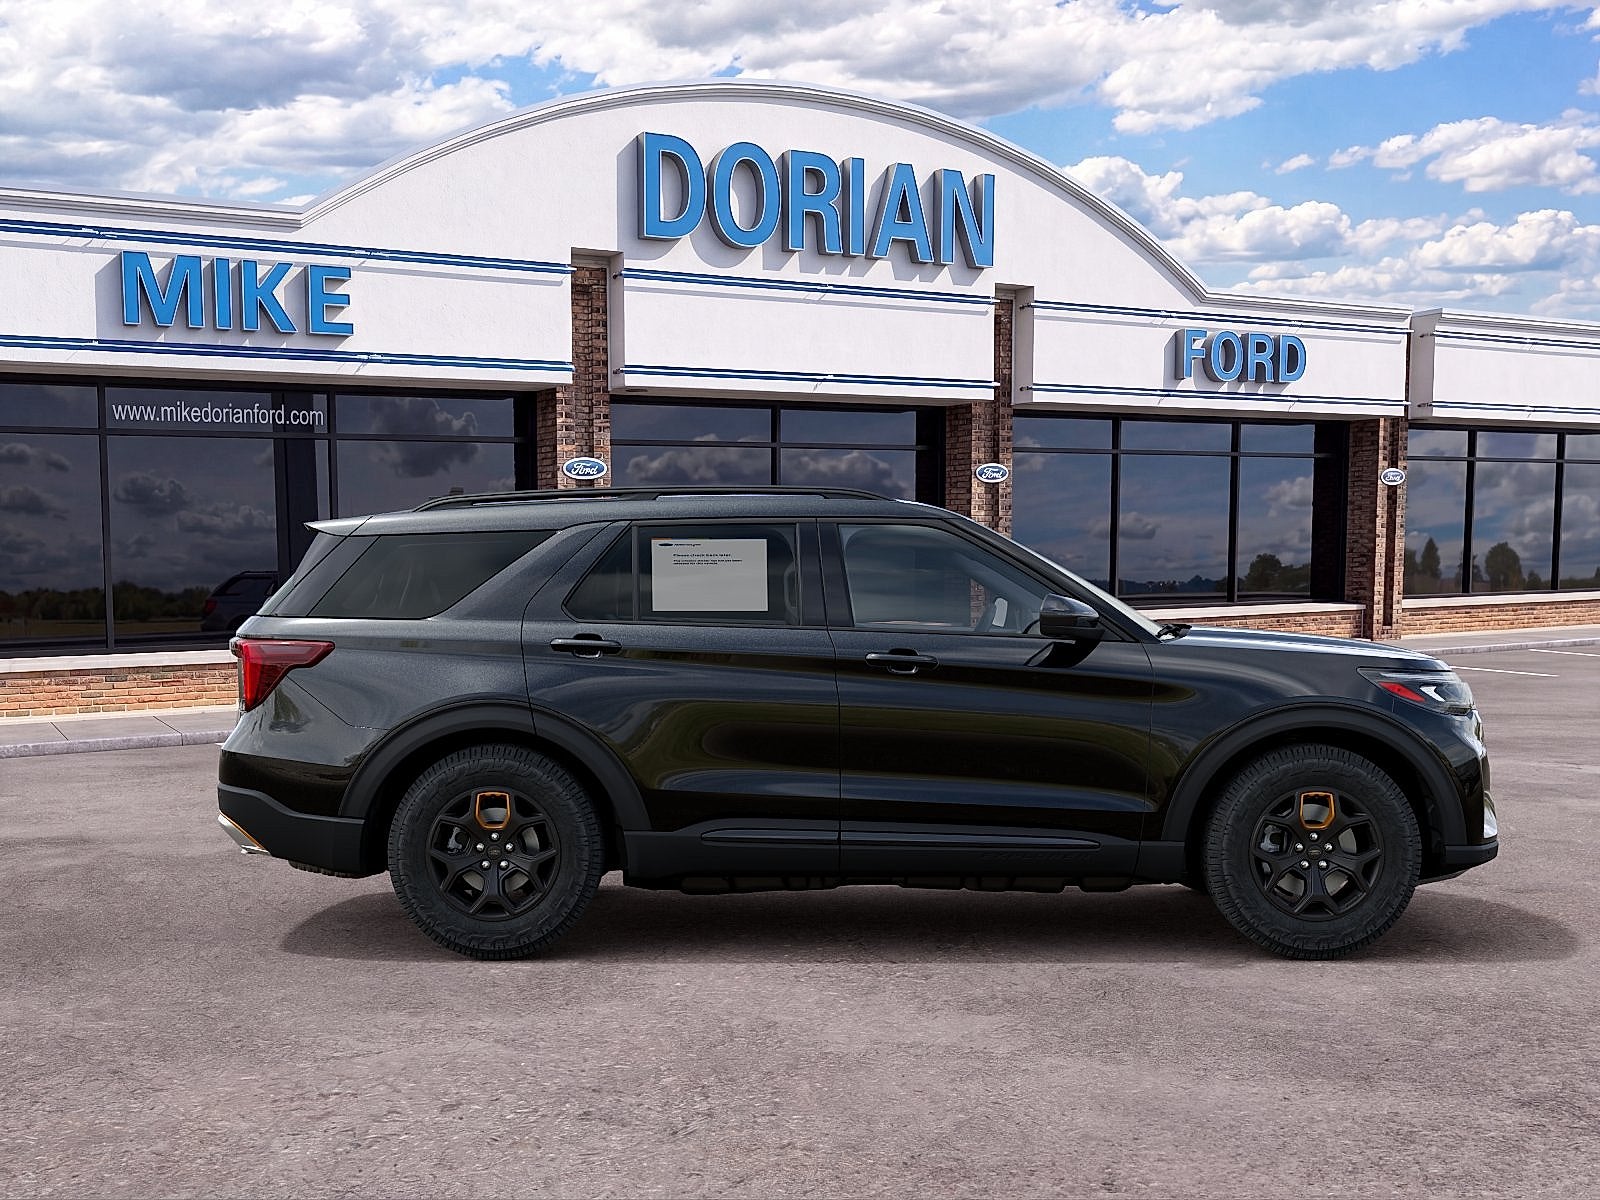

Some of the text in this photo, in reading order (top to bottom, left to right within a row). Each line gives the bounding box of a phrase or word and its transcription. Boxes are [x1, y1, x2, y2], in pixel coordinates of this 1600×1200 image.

[638, 132, 995, 269] DORIAN
[120, 251, 354, 336] MIKE
[1177, 328, 1306, 384] FORD
[112, 401, 324, 425] www.mikedorianford.com
[571, 462, 598, 474] Ford
